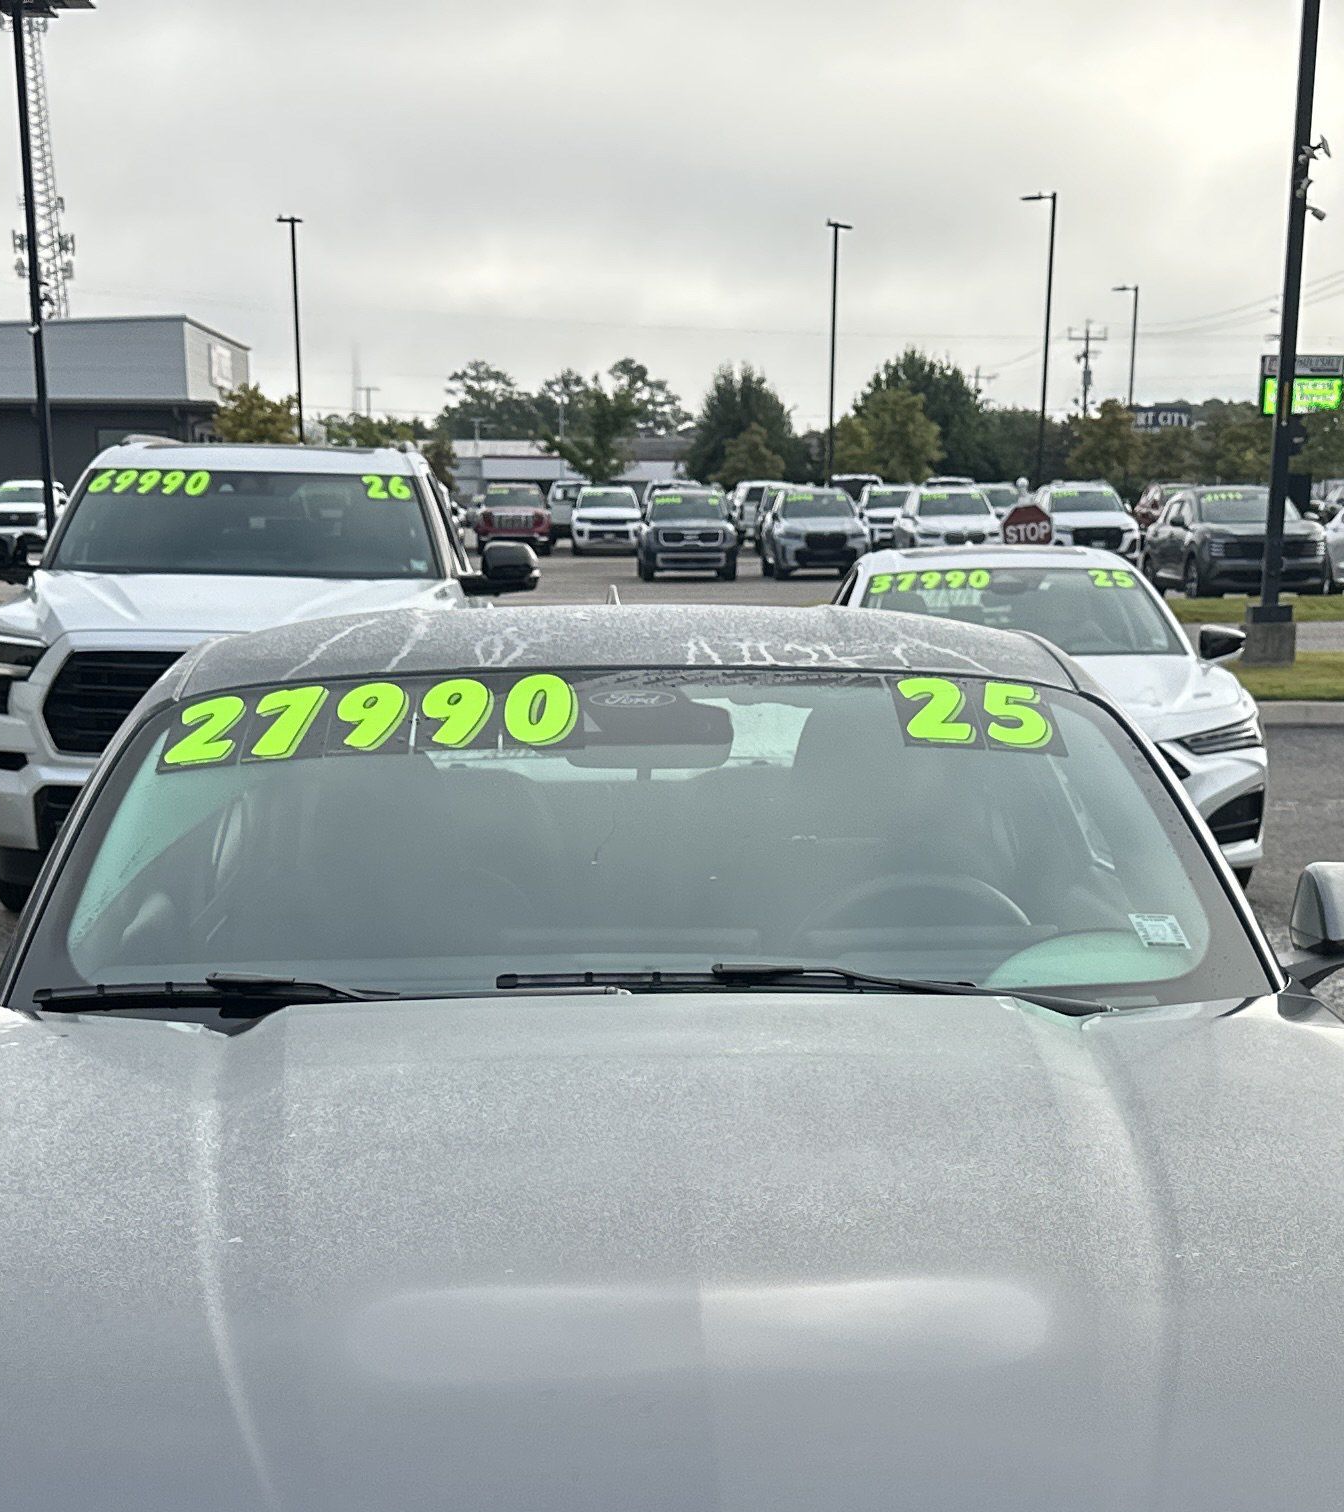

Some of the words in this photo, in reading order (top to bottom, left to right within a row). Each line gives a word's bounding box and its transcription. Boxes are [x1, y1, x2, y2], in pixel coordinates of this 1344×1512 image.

[88, 470, 211, 496] 69990
[362, 474, 411, 499] 26
[1006, 521, 1051, 544] STOP
[1088, 569, 1136, 589] 25
[163, 673, 579, 765] 27990
[897, 677, 1052, 748] 25
